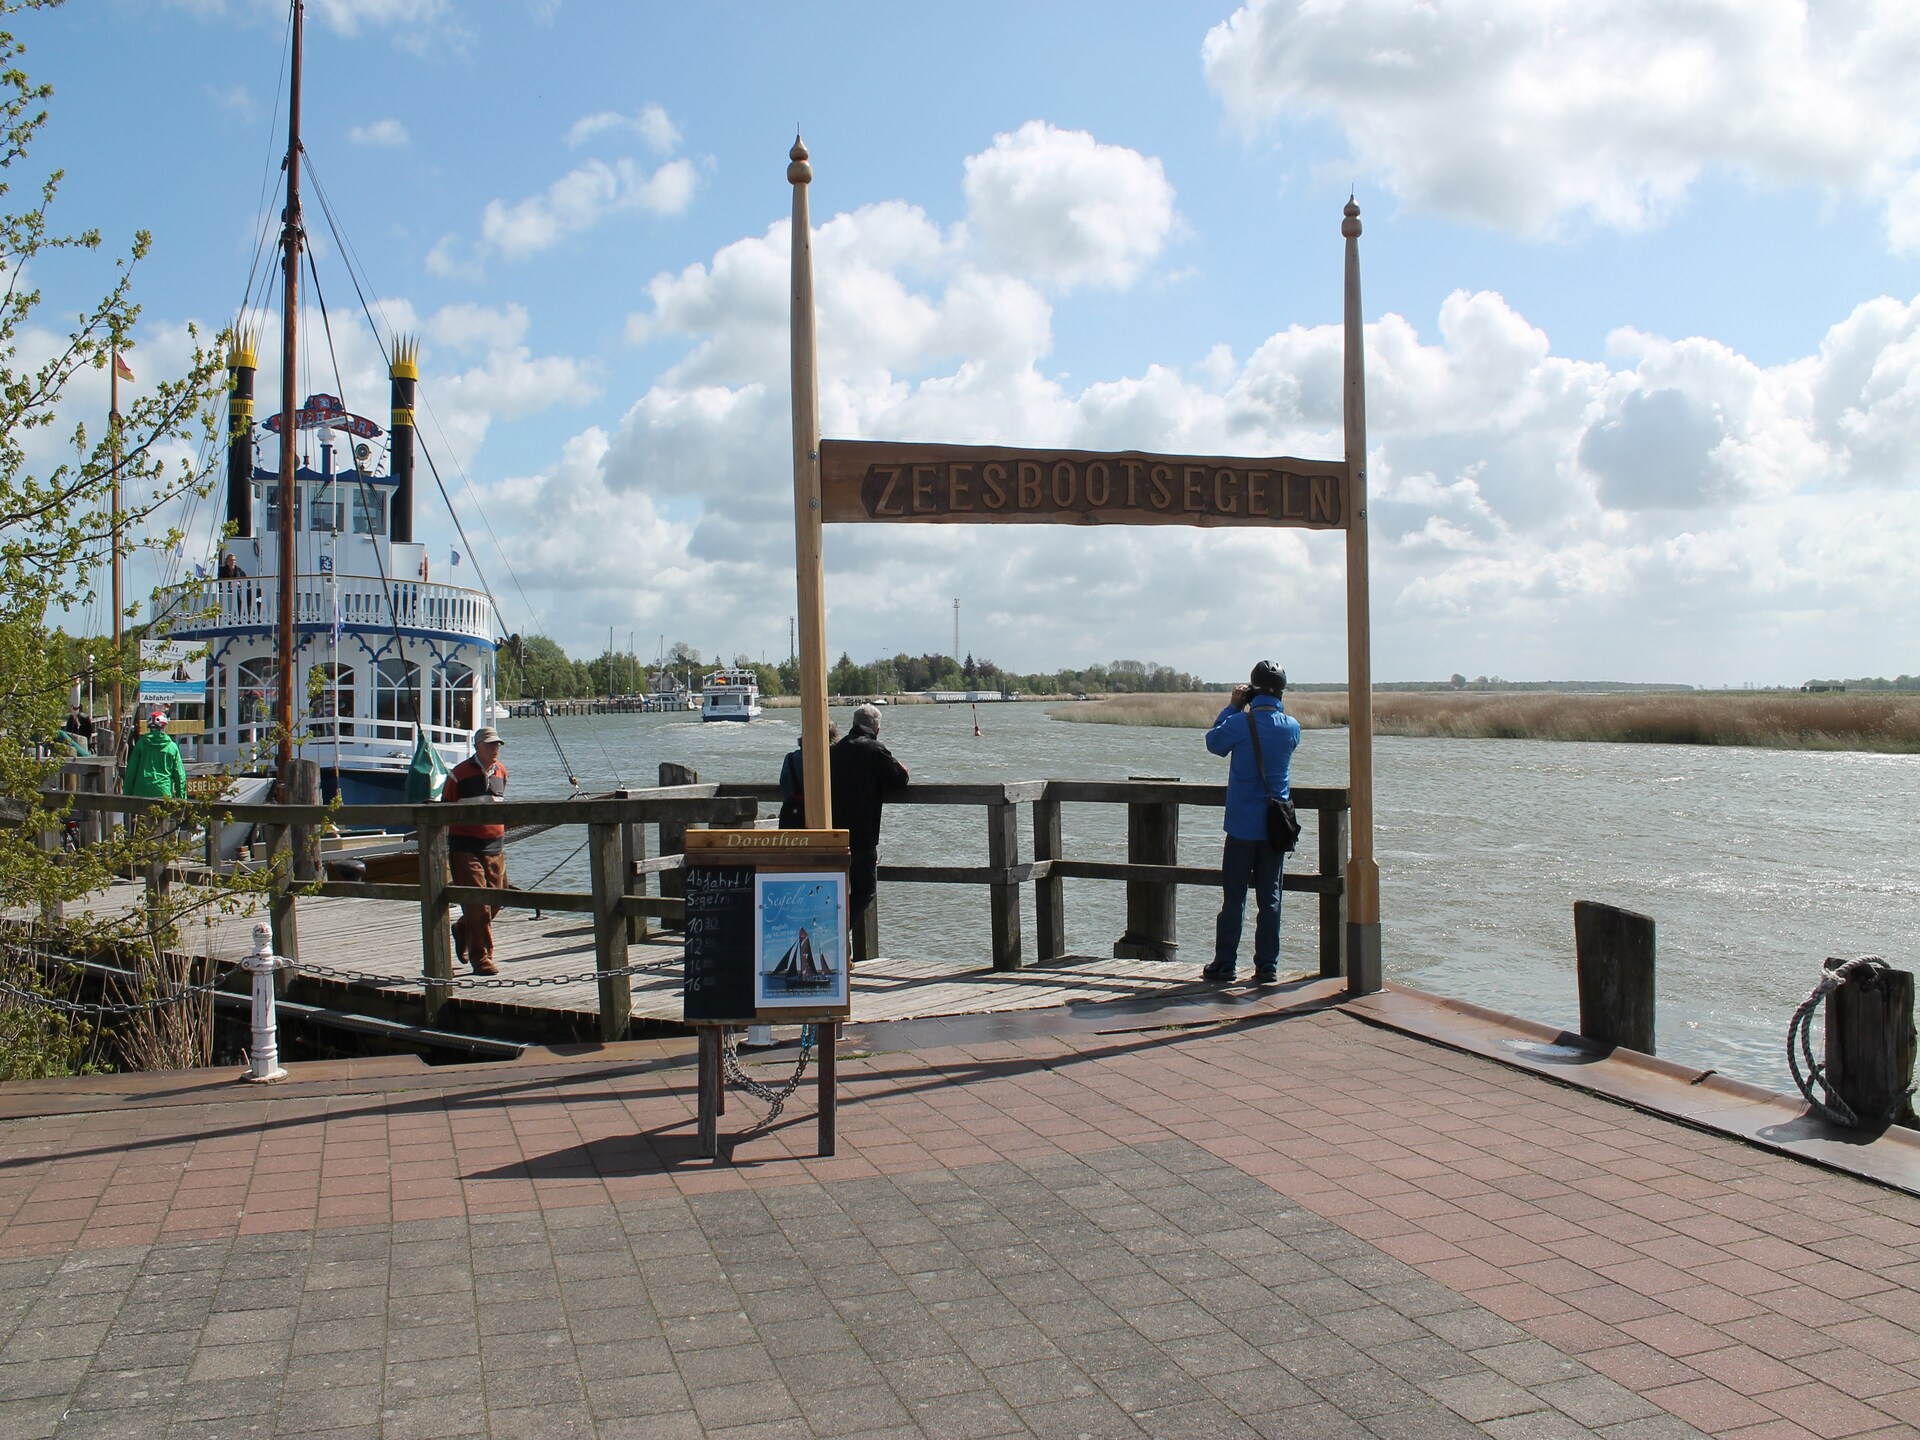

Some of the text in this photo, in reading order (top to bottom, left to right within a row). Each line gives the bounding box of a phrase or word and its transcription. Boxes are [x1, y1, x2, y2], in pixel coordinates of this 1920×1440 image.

[873, 457, 1335, 521] ZEESBOOTSEGELN
[727, 831, 810, 848] Dorothea
[687, 869, 740, 893] Abfahrt
[763, 884, 806, 923] Segeln
